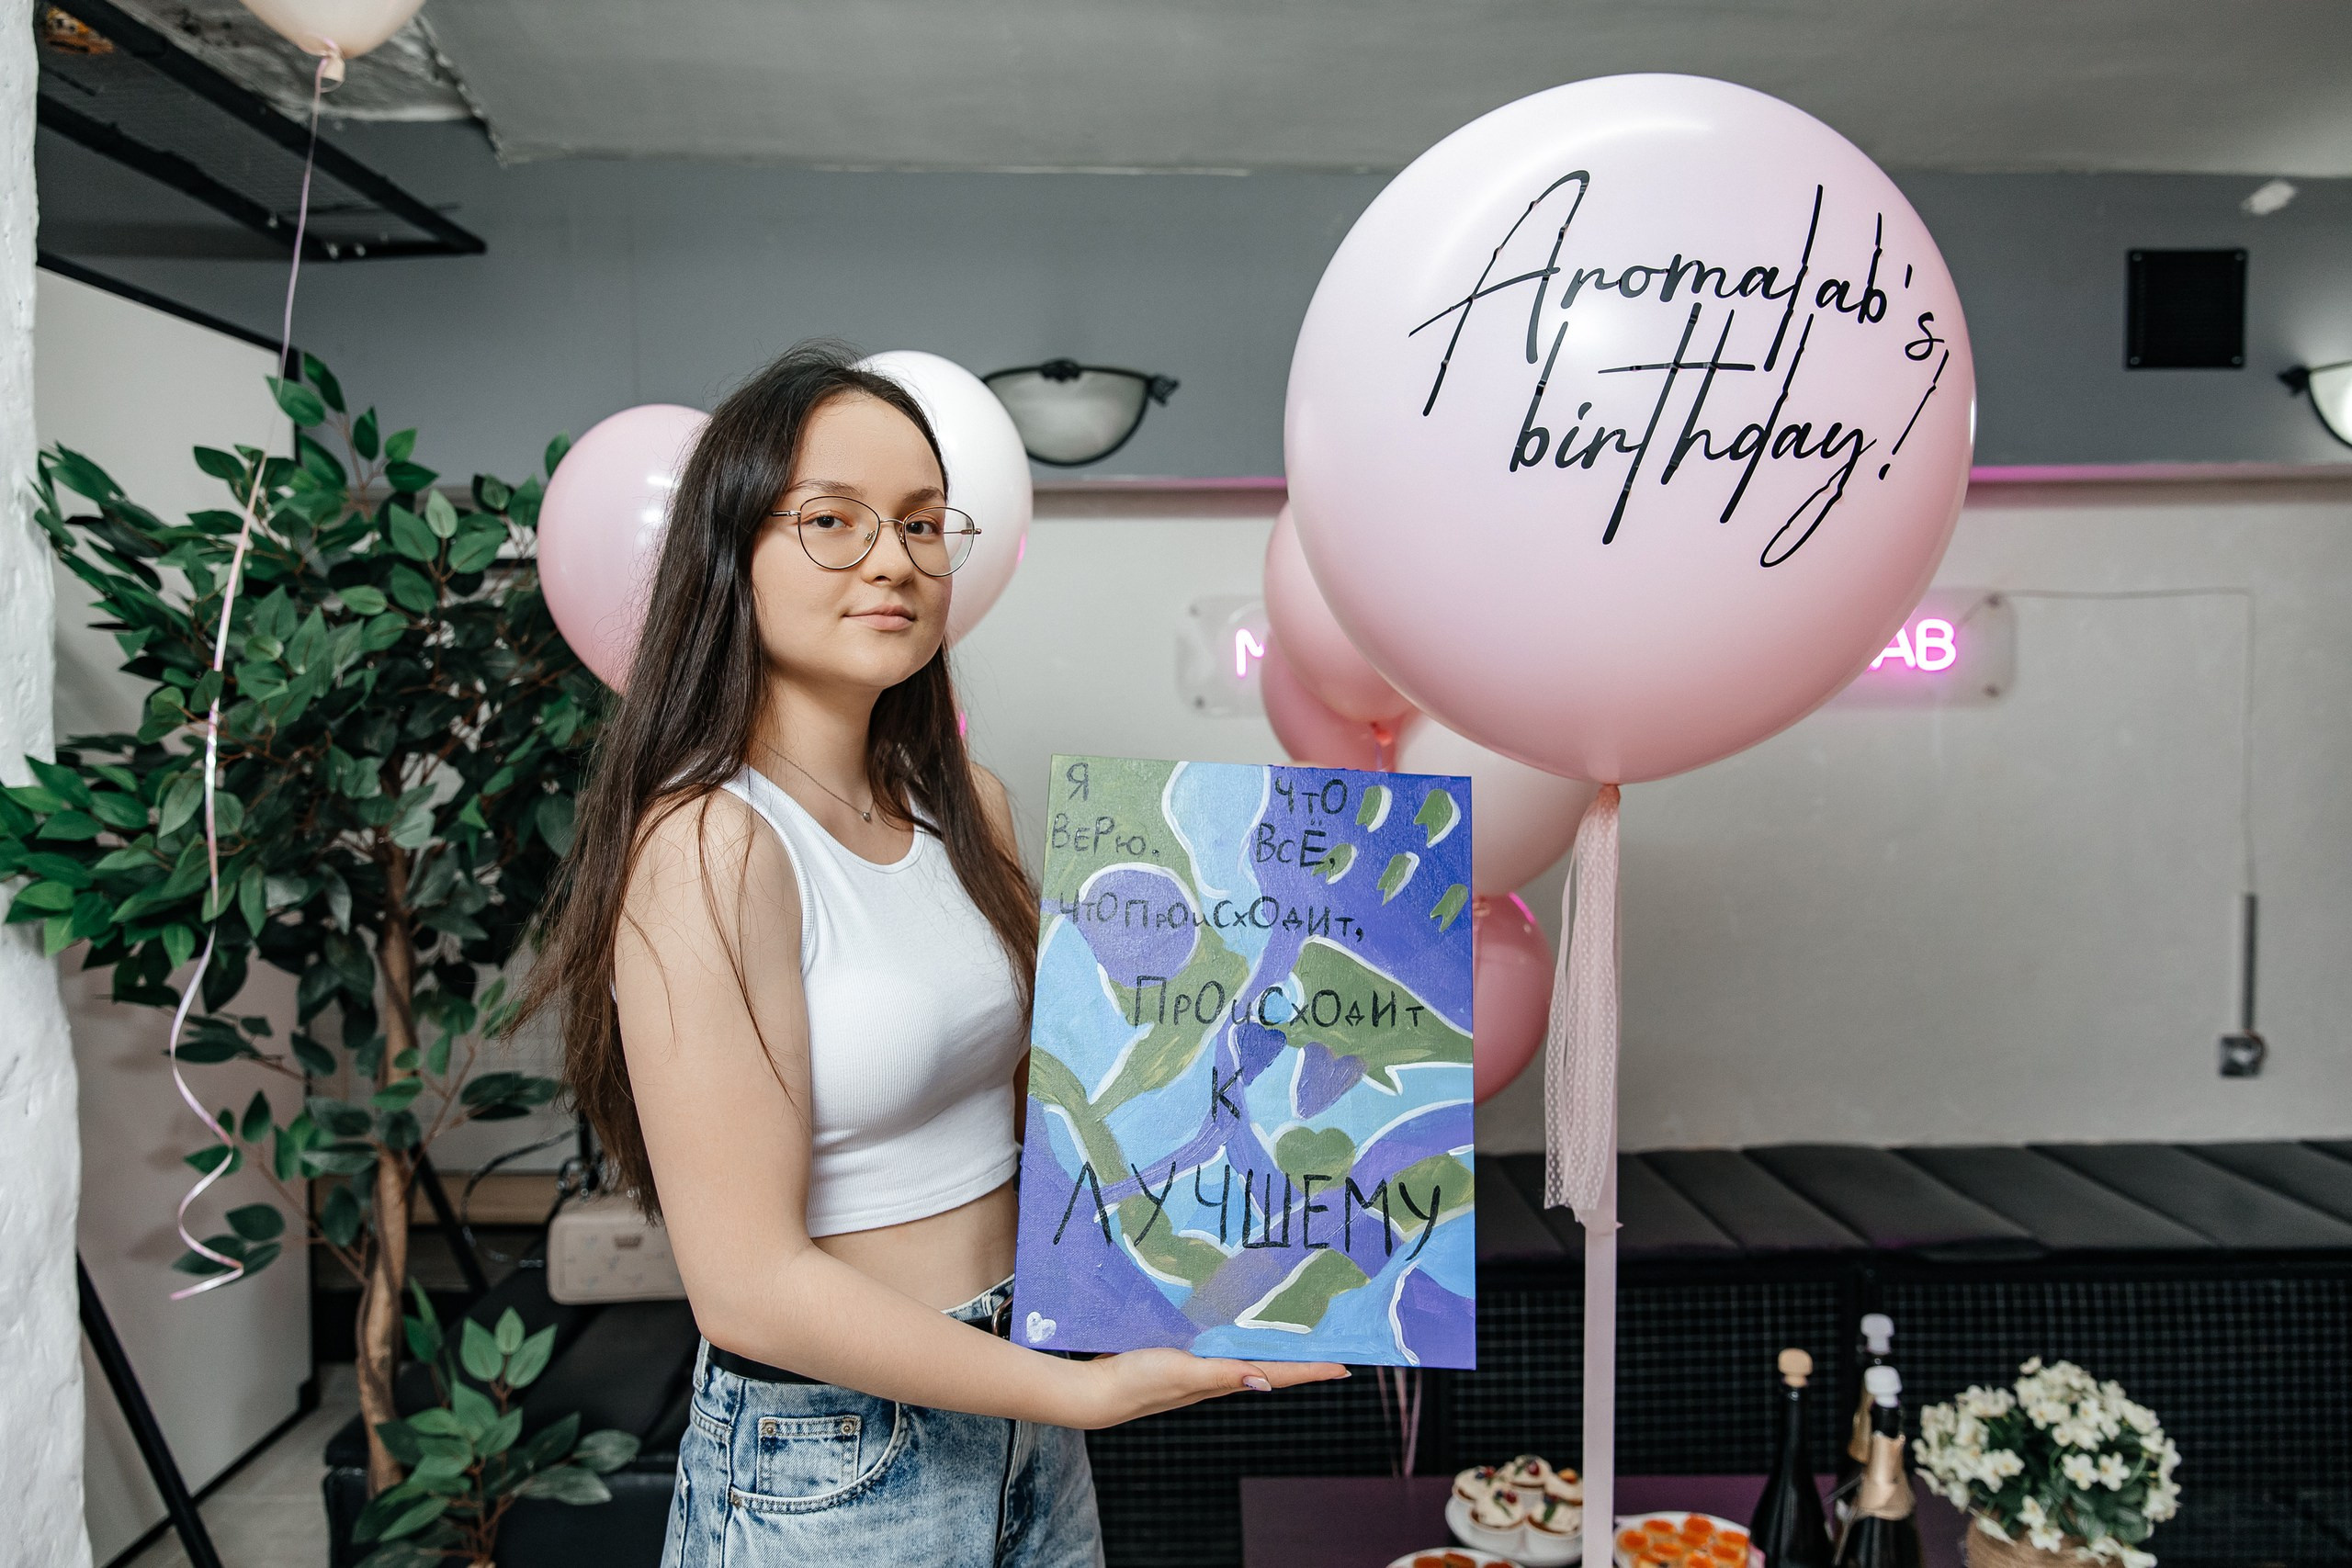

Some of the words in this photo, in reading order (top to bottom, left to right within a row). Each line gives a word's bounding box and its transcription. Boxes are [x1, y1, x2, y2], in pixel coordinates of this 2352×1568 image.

[1408, 169, 1946, 417] Aromalab's
[1509, 301, 1950, 569] birthday!
[1868, 618, 1957, 672] AB
[1066, 762, 1089, 802] Я
[1053, 1160, 1442, 1261] ЛУЧШЕМУ
